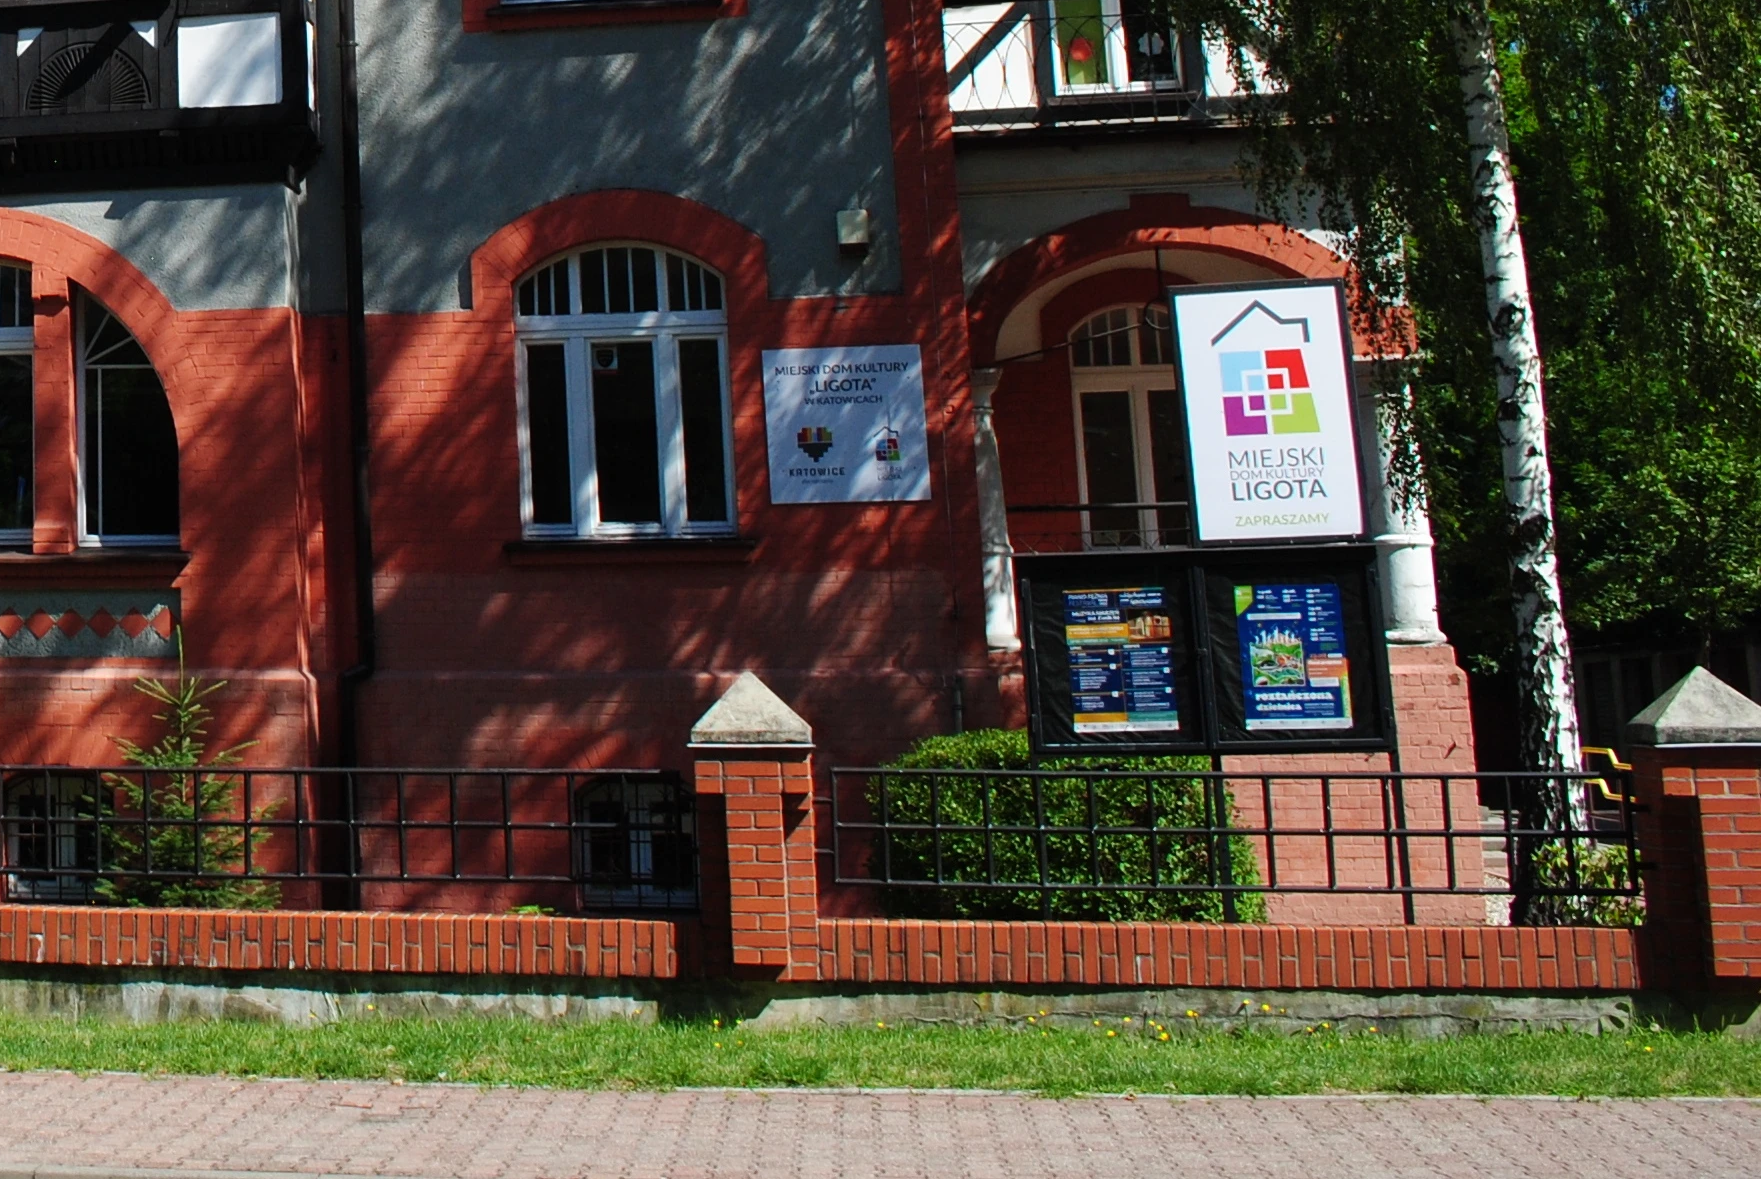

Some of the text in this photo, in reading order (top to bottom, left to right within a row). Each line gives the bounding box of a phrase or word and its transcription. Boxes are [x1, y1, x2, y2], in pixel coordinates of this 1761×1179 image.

[775, 362, 909, 376] MIEJSKI DOM KULTURY
[817, 395, 883, 405] KATOWICACH
[1228, 447, 1325, 469] MIEJSKI
[789, 467, 846, 477] KATOWICE
[1230, 467, 1325, 481] DOM KULTURY
[1231, 479, 1328, 501] LIGOTA
[1235, 513, 1330, 527] ZAPRASZAMY
